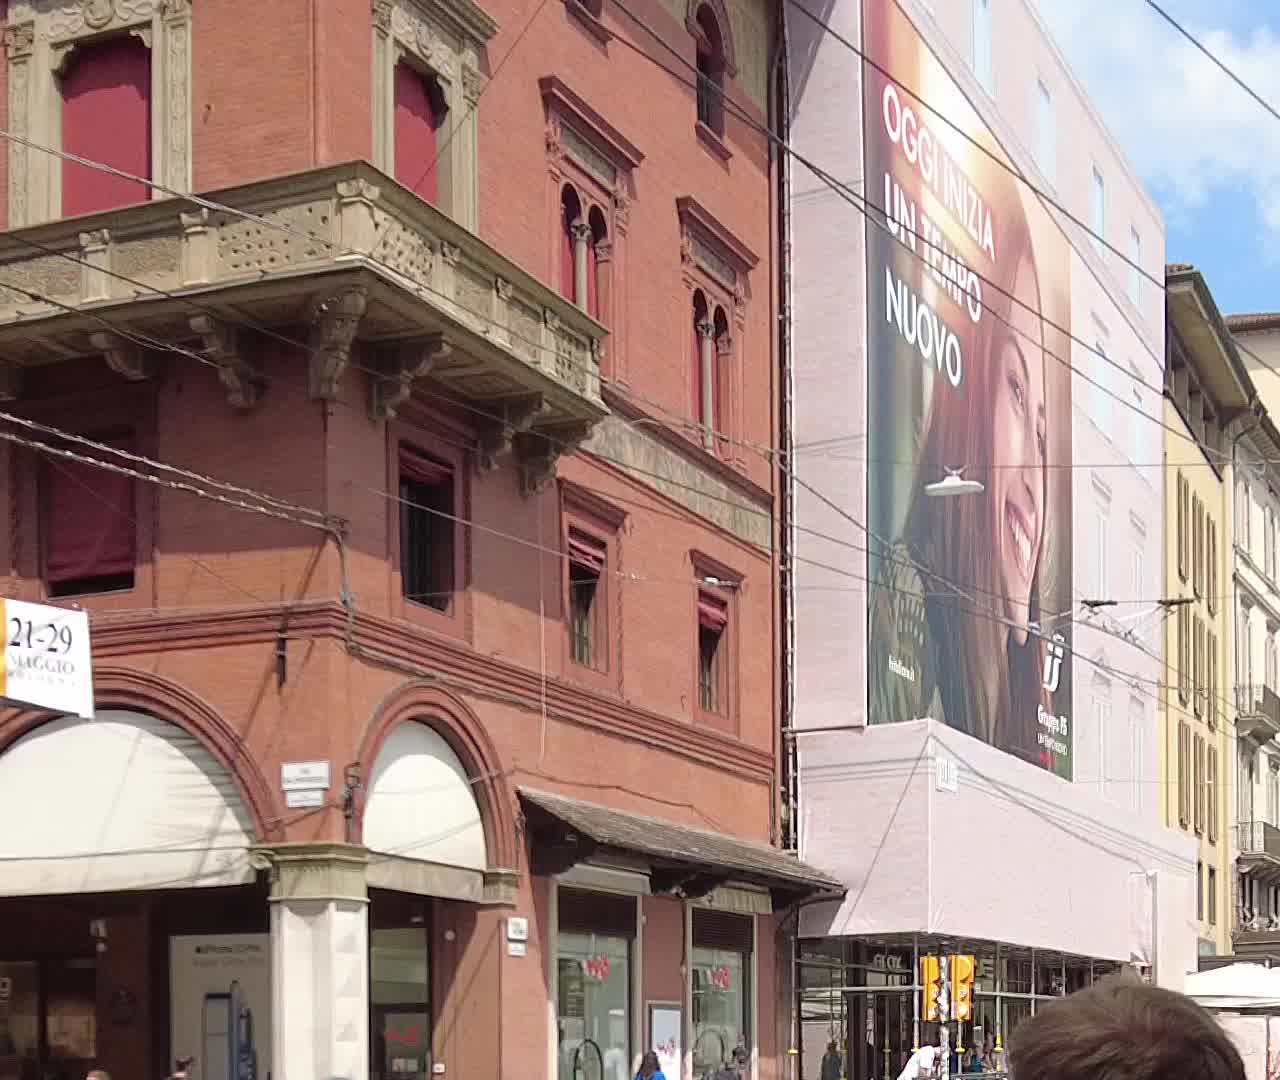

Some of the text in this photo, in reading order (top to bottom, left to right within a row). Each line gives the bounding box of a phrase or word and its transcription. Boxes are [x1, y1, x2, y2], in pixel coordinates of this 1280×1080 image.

[882, 83, 996, 265] OGGI INIZIA
[884, 172, 982, 323] UN TEMPO
[885, 264, 962, 387] NUOVO
[8, 616, 73, 655] 21-29
